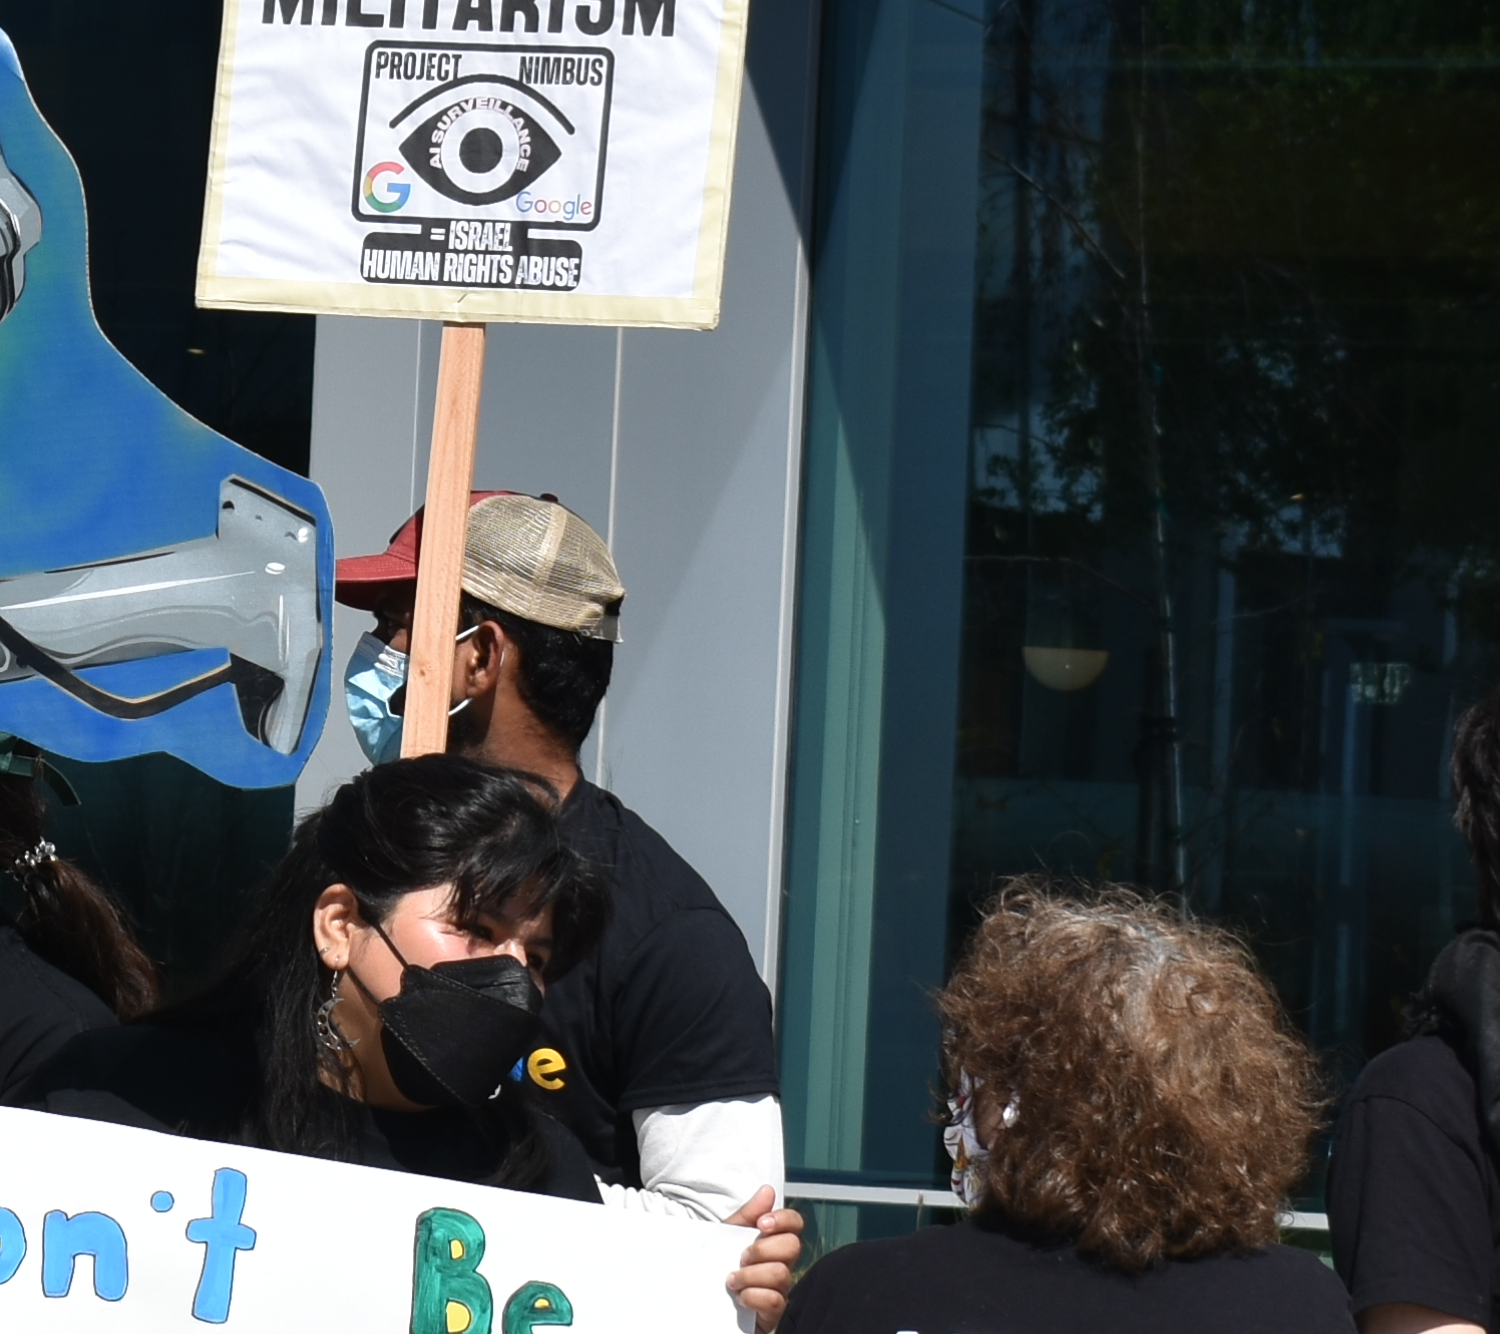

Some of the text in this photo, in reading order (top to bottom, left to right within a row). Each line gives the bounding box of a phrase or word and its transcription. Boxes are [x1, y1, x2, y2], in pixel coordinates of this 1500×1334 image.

[375, 51, 605, 87] PROJECT NIMBUS
[429, 96, 532, 174] AI SURVEILLANCE
[515, 189, 593, 221] Google
[448, 219, 514, 252] ISRAEL
[362, 248, 579, 289] HUMAN RIGHTS ABUSE
